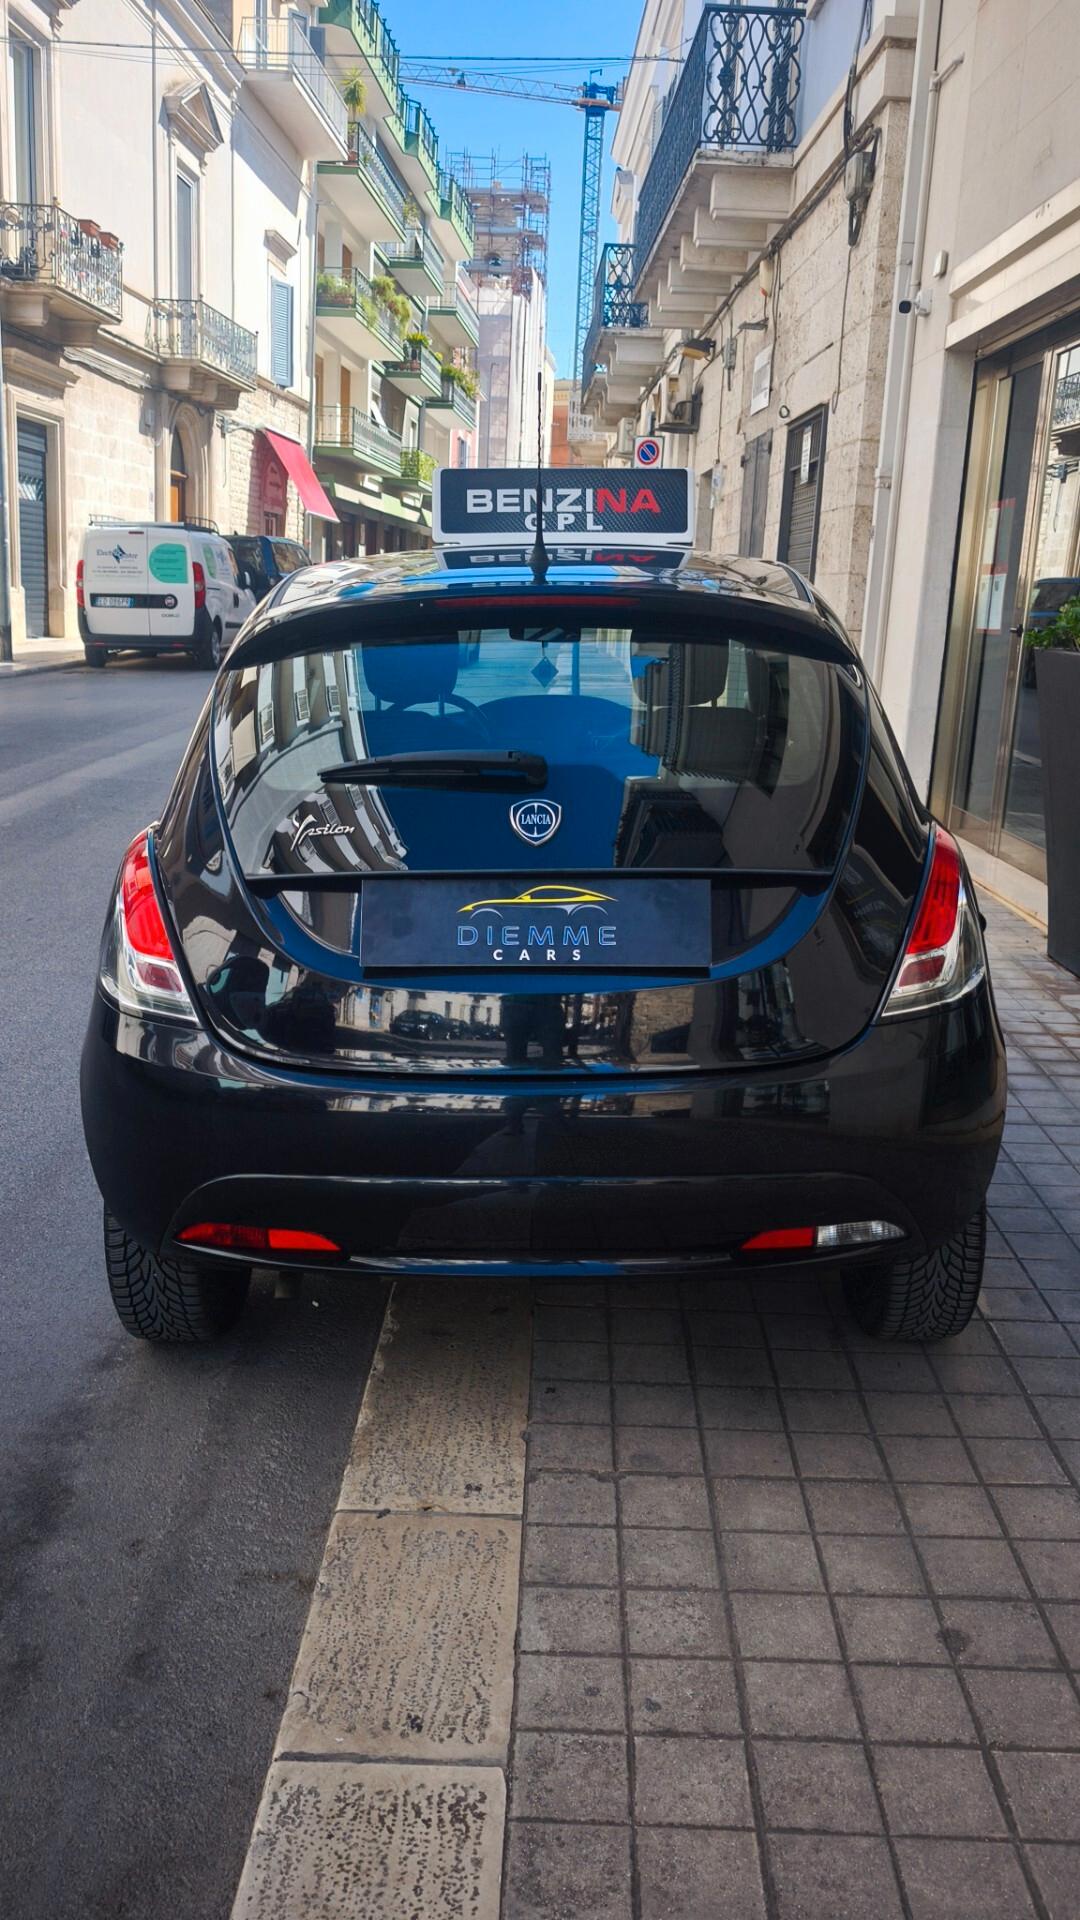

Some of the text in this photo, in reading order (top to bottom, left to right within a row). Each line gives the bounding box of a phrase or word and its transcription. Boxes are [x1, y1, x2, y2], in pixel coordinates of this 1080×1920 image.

[466, 488, 662, 514] BENZINA
[525, 514, 604, 532] GPL
[520, 814, 552, 825] LANCIA
[290, 812, 357, 851] Ypsilon
[456, 925, 617, 946] DIEMME
[493, 948, 582, 961] CARS
